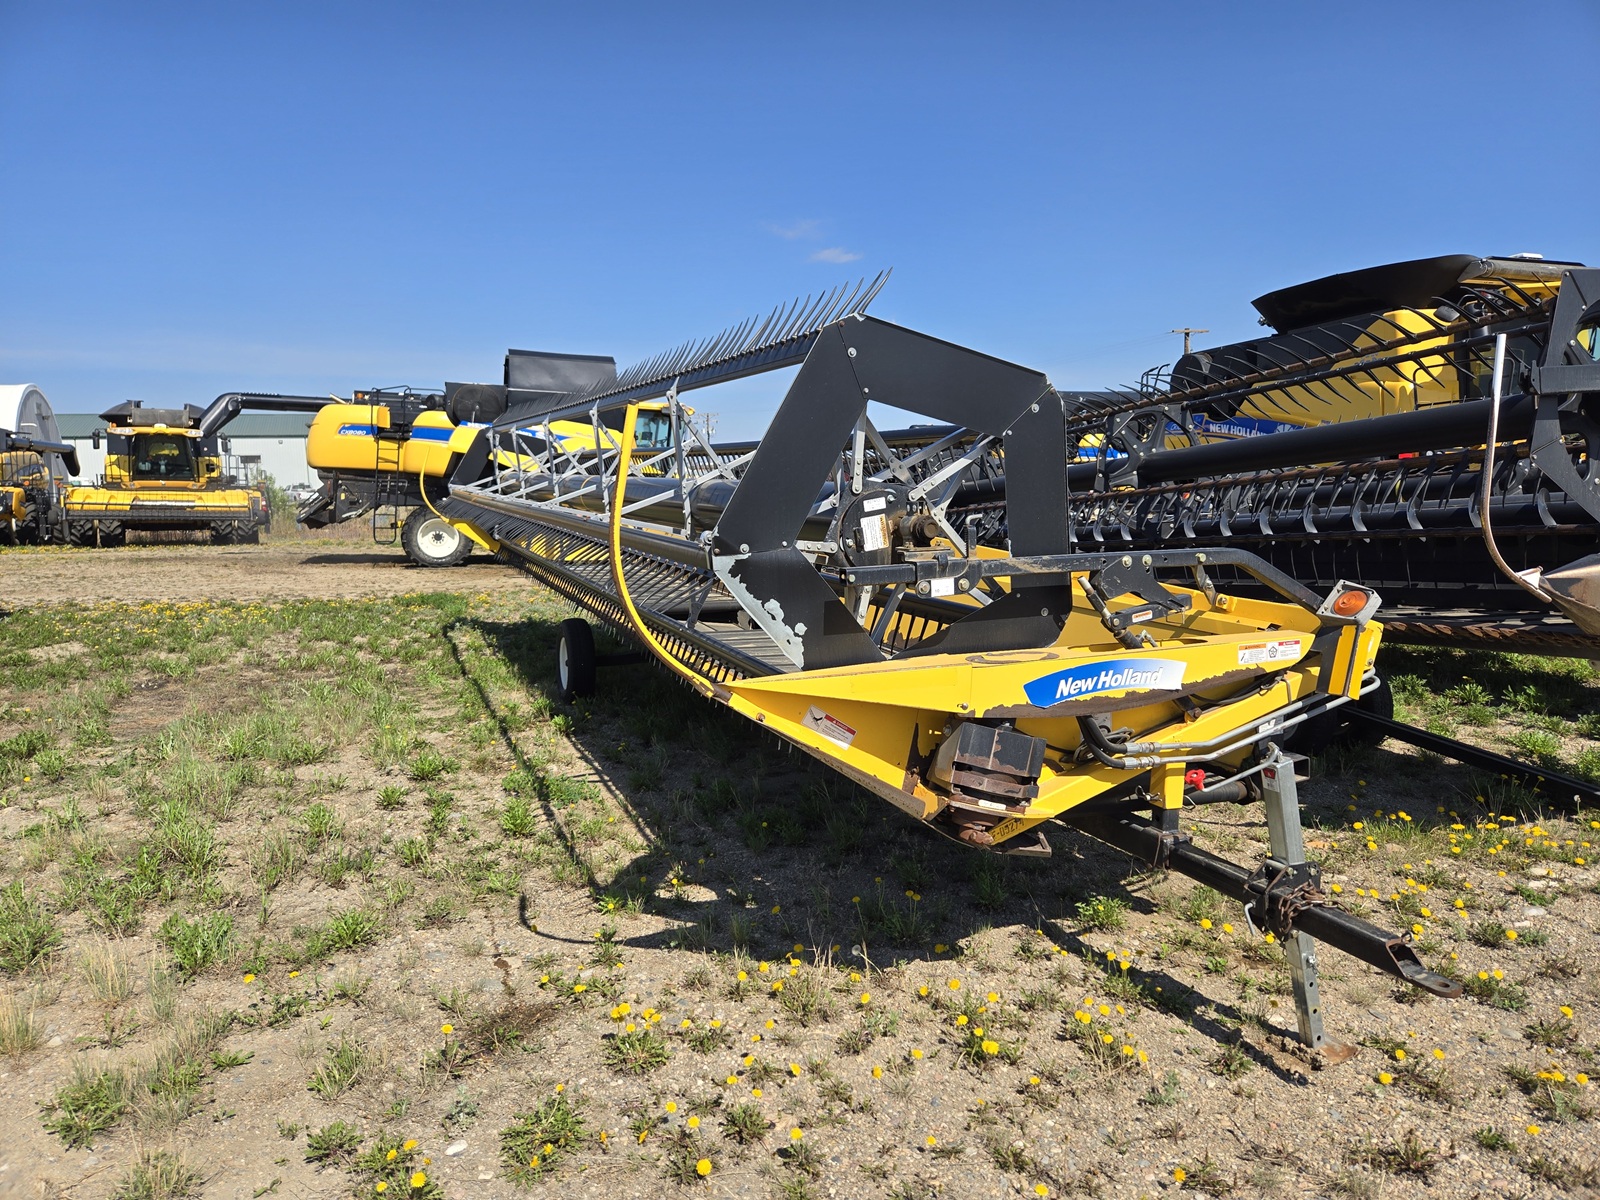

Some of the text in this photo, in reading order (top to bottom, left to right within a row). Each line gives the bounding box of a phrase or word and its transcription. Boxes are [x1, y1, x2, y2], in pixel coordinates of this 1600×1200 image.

[1209, 423, 1230, 433] NEW
[1055, 667, 1163, 699] New Holland
